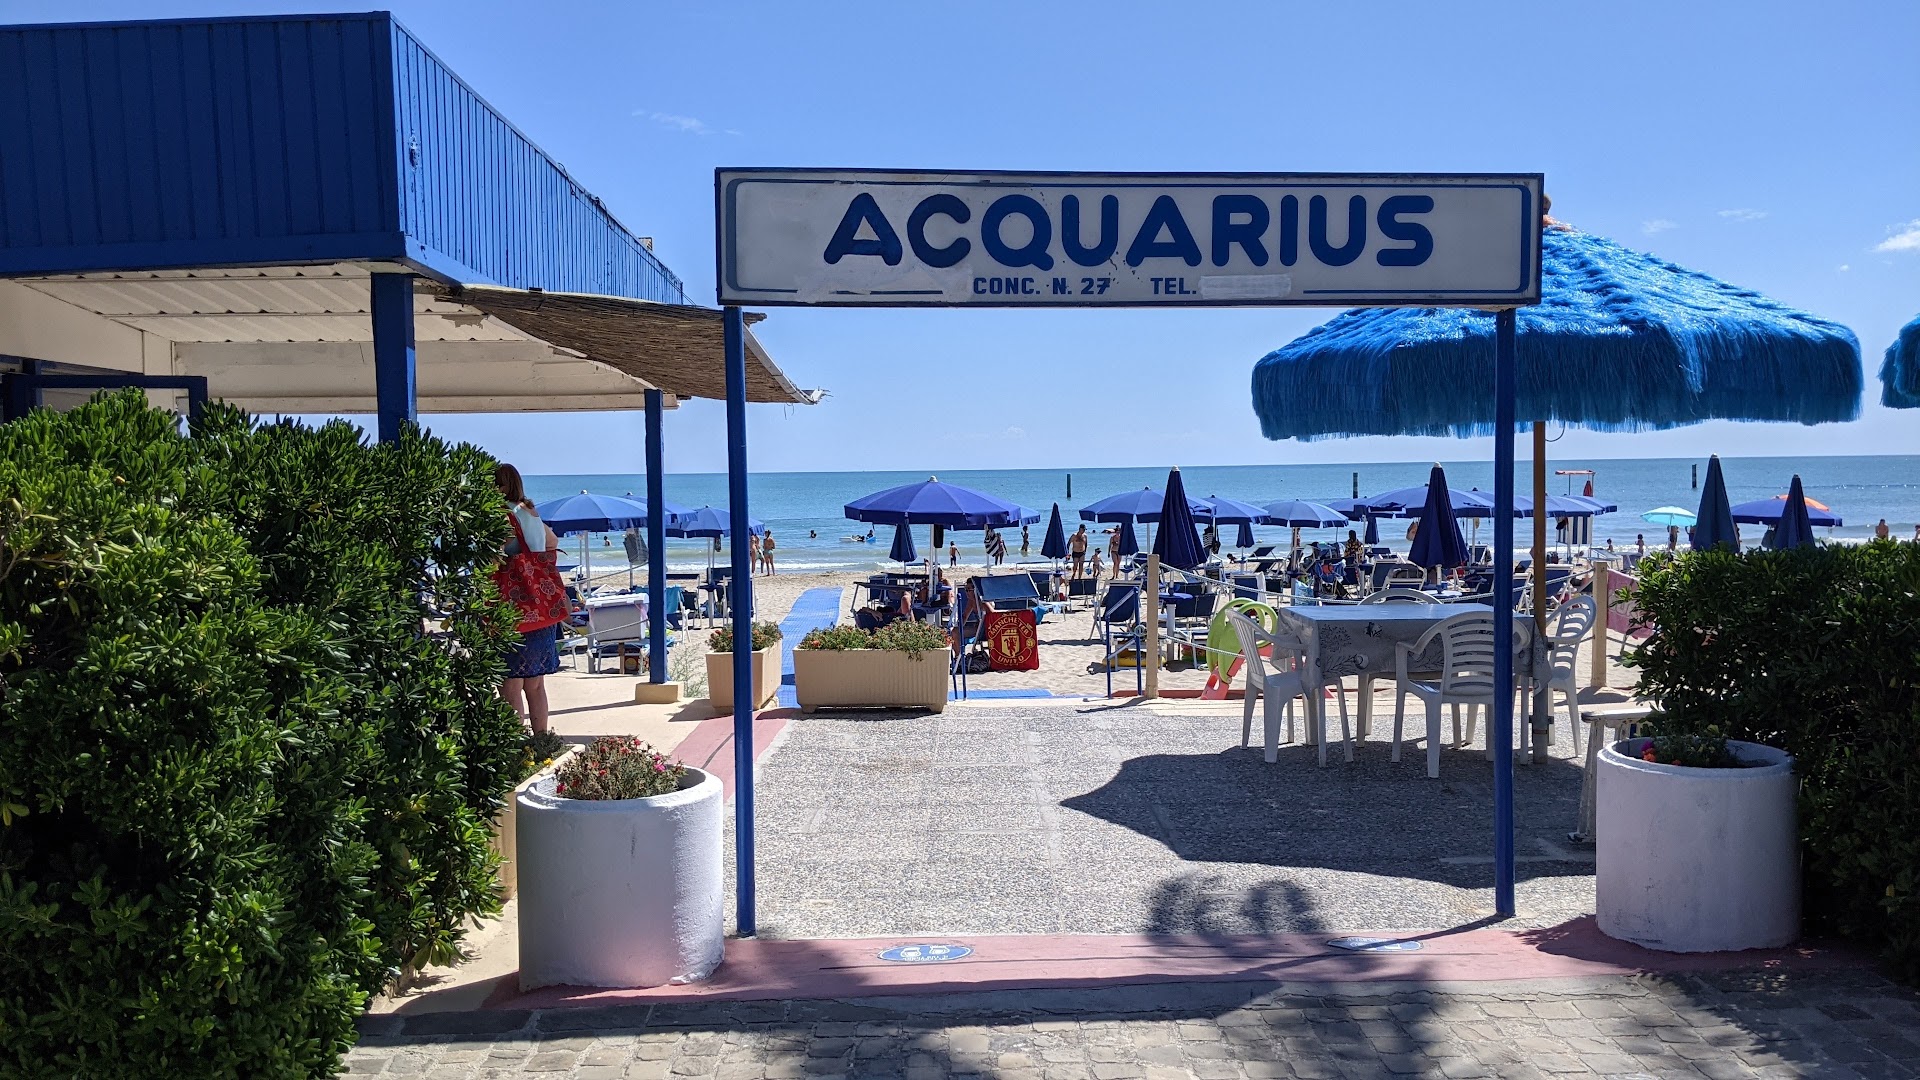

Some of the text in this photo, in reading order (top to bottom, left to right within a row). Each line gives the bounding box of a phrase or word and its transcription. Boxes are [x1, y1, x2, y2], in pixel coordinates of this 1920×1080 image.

[823, 192, 1434, 271] ACQUARIUS
[973, 277, 1197, 295] CONC. N. 27 TEL.
[990, 616, 1030, 636] MANCHETER
[997, 655, 1025, 664] UNITD
